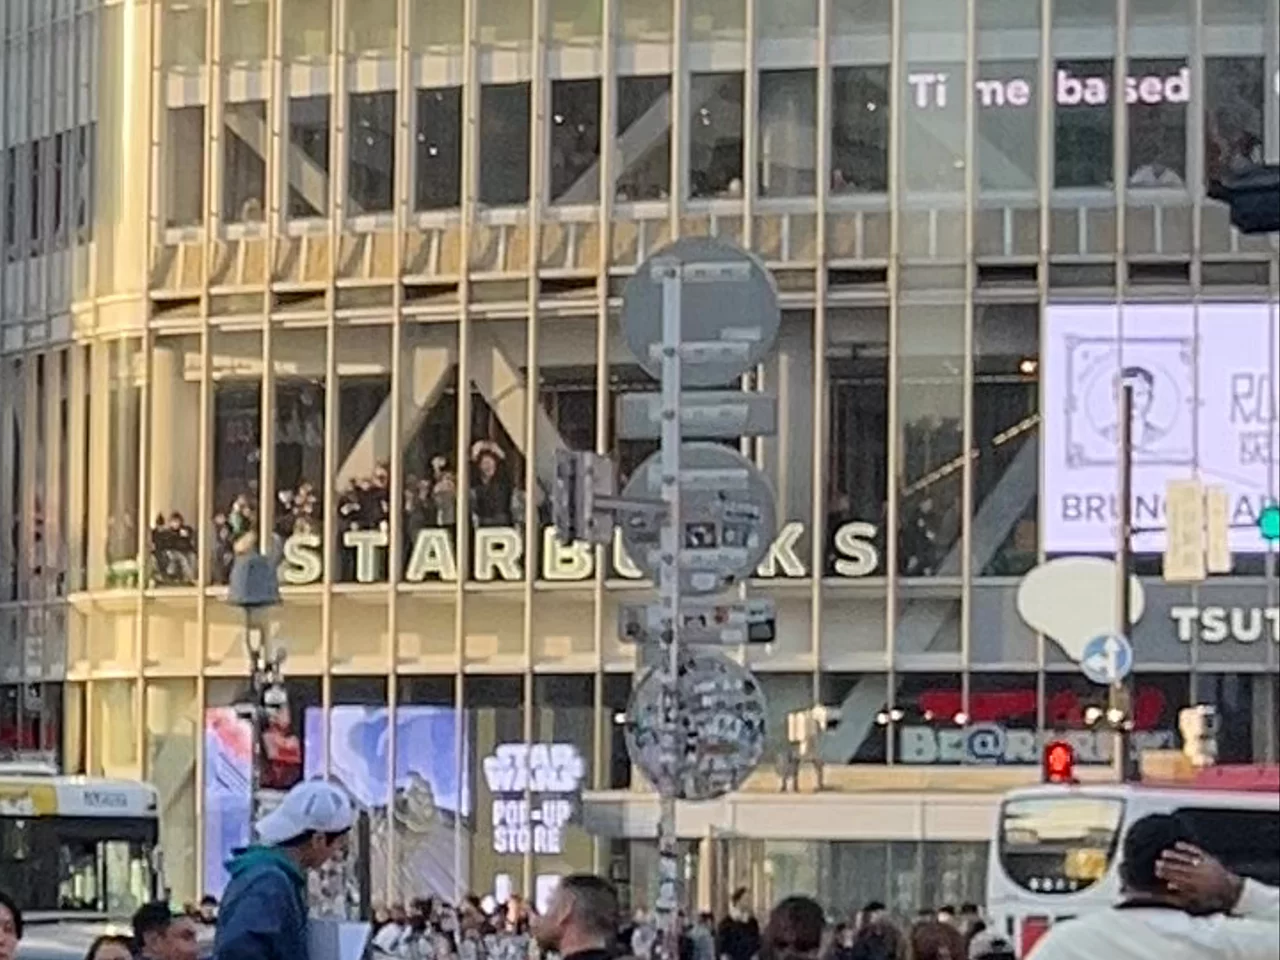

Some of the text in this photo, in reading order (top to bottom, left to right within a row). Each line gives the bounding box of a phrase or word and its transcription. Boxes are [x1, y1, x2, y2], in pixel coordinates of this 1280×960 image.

[907, 67, 1191, 108] Time based
[492, 799, 571, 828] POP-UP
[493, 825, 562, 854] STORE
